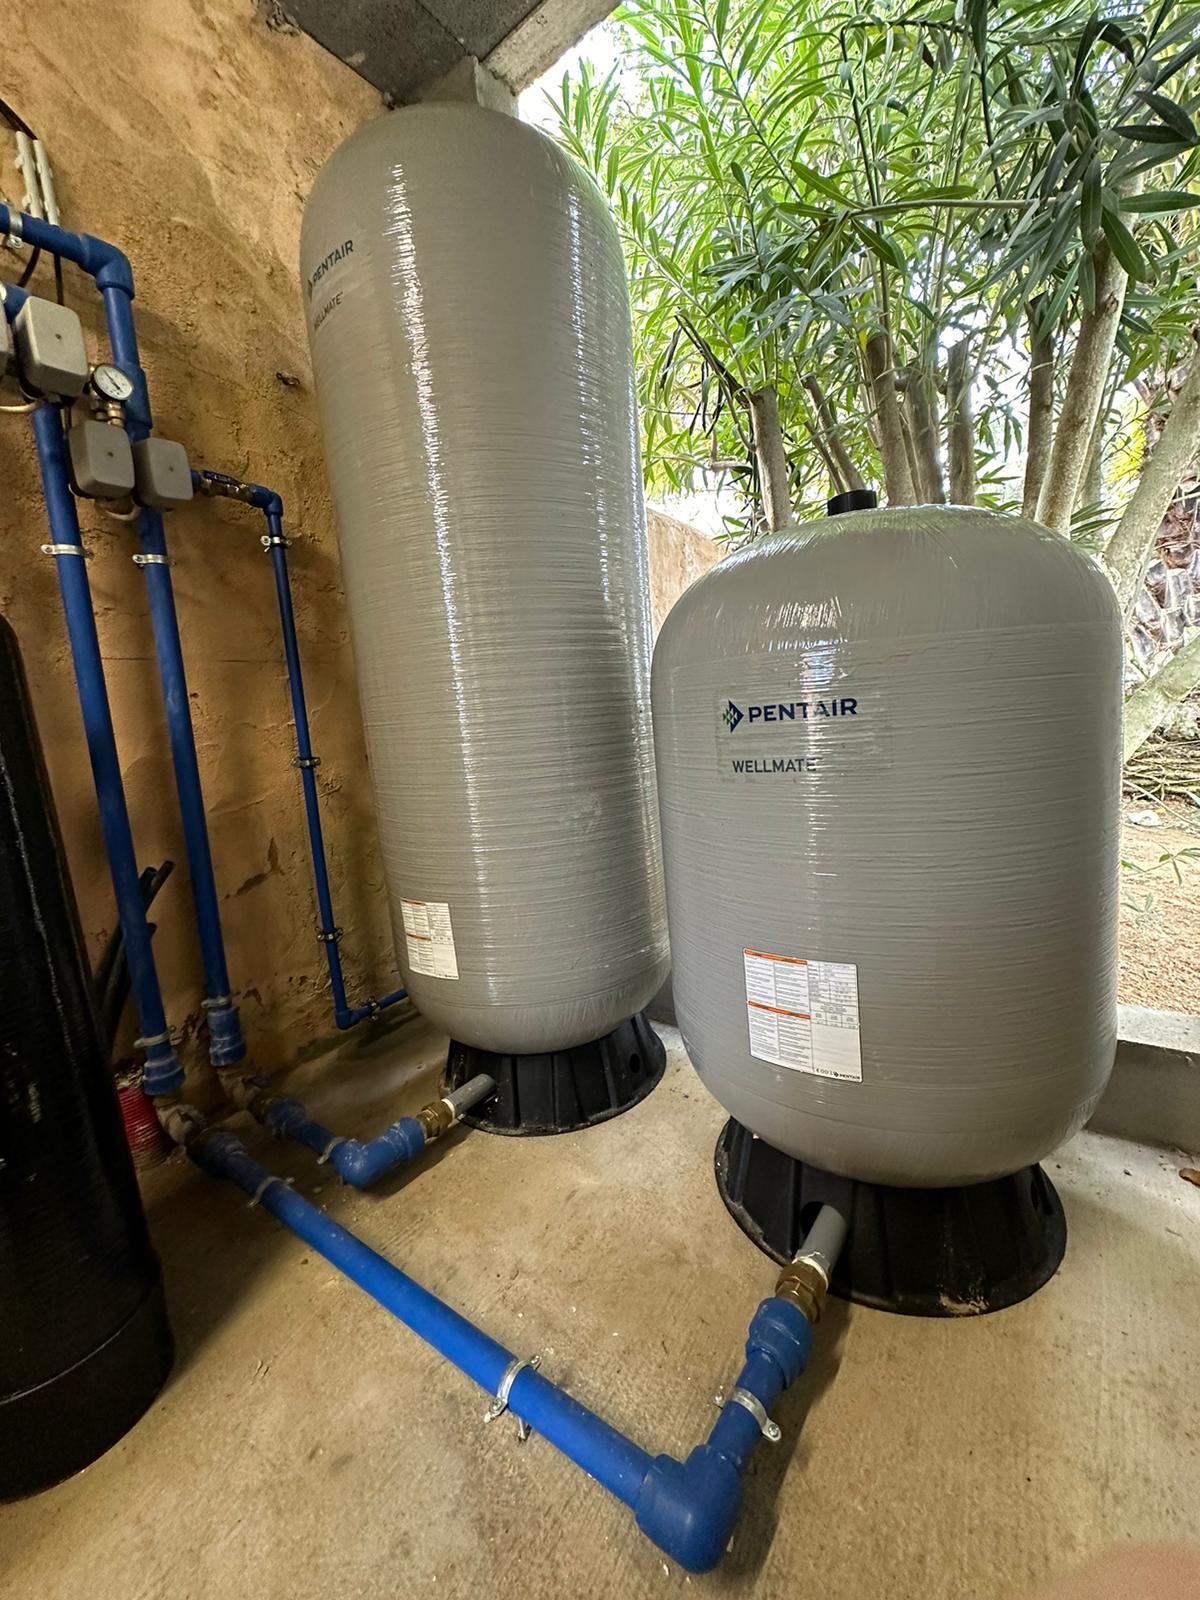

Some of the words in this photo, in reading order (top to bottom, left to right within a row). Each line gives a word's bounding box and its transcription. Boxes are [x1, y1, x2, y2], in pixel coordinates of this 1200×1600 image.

[312, 240, 354, 287] PENTAIR
[748, 698, 858, 723] PENTAIR
[732, 758, 817, 773] WELLMATE
